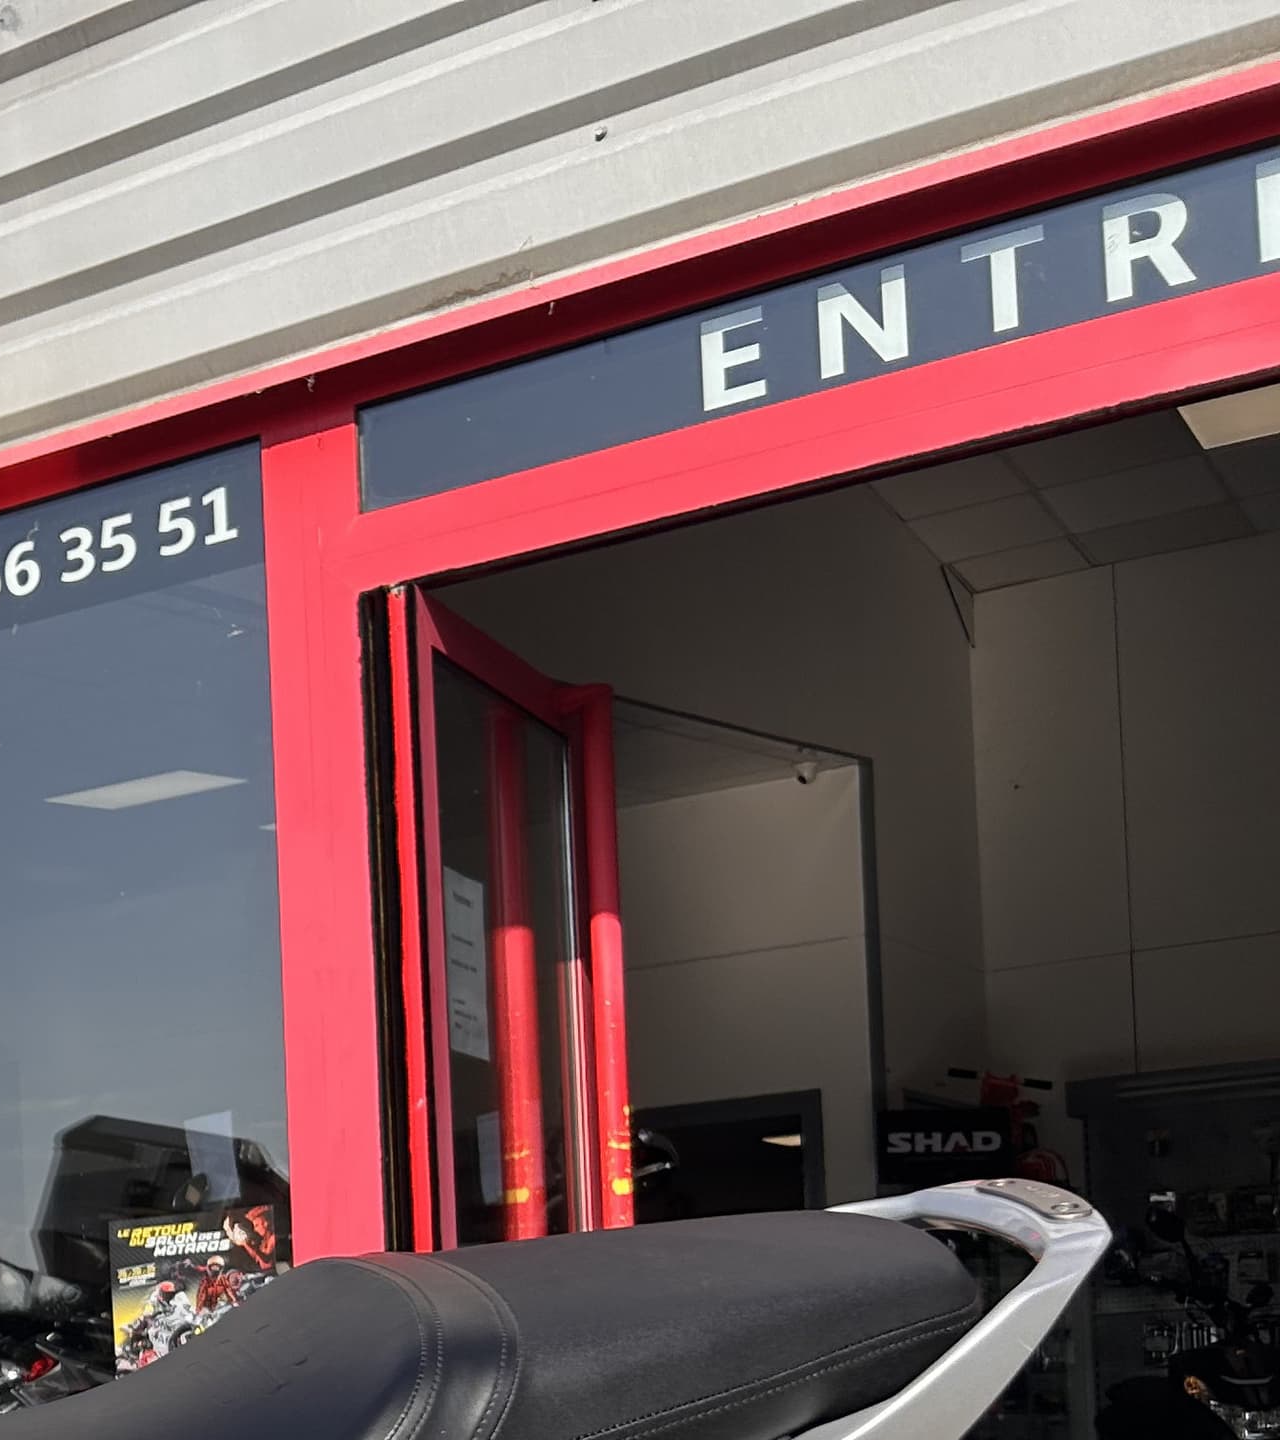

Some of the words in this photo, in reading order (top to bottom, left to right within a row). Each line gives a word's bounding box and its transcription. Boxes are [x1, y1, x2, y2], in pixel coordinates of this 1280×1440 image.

[59, 513, 137, 584] 35
[157, 486, 239, 557] 51
[887, 1131, 1002, 1153] SHAD
[130, 1222, 195, 1239] RETOUR
[145, 1232, 197, 1248] SALON
